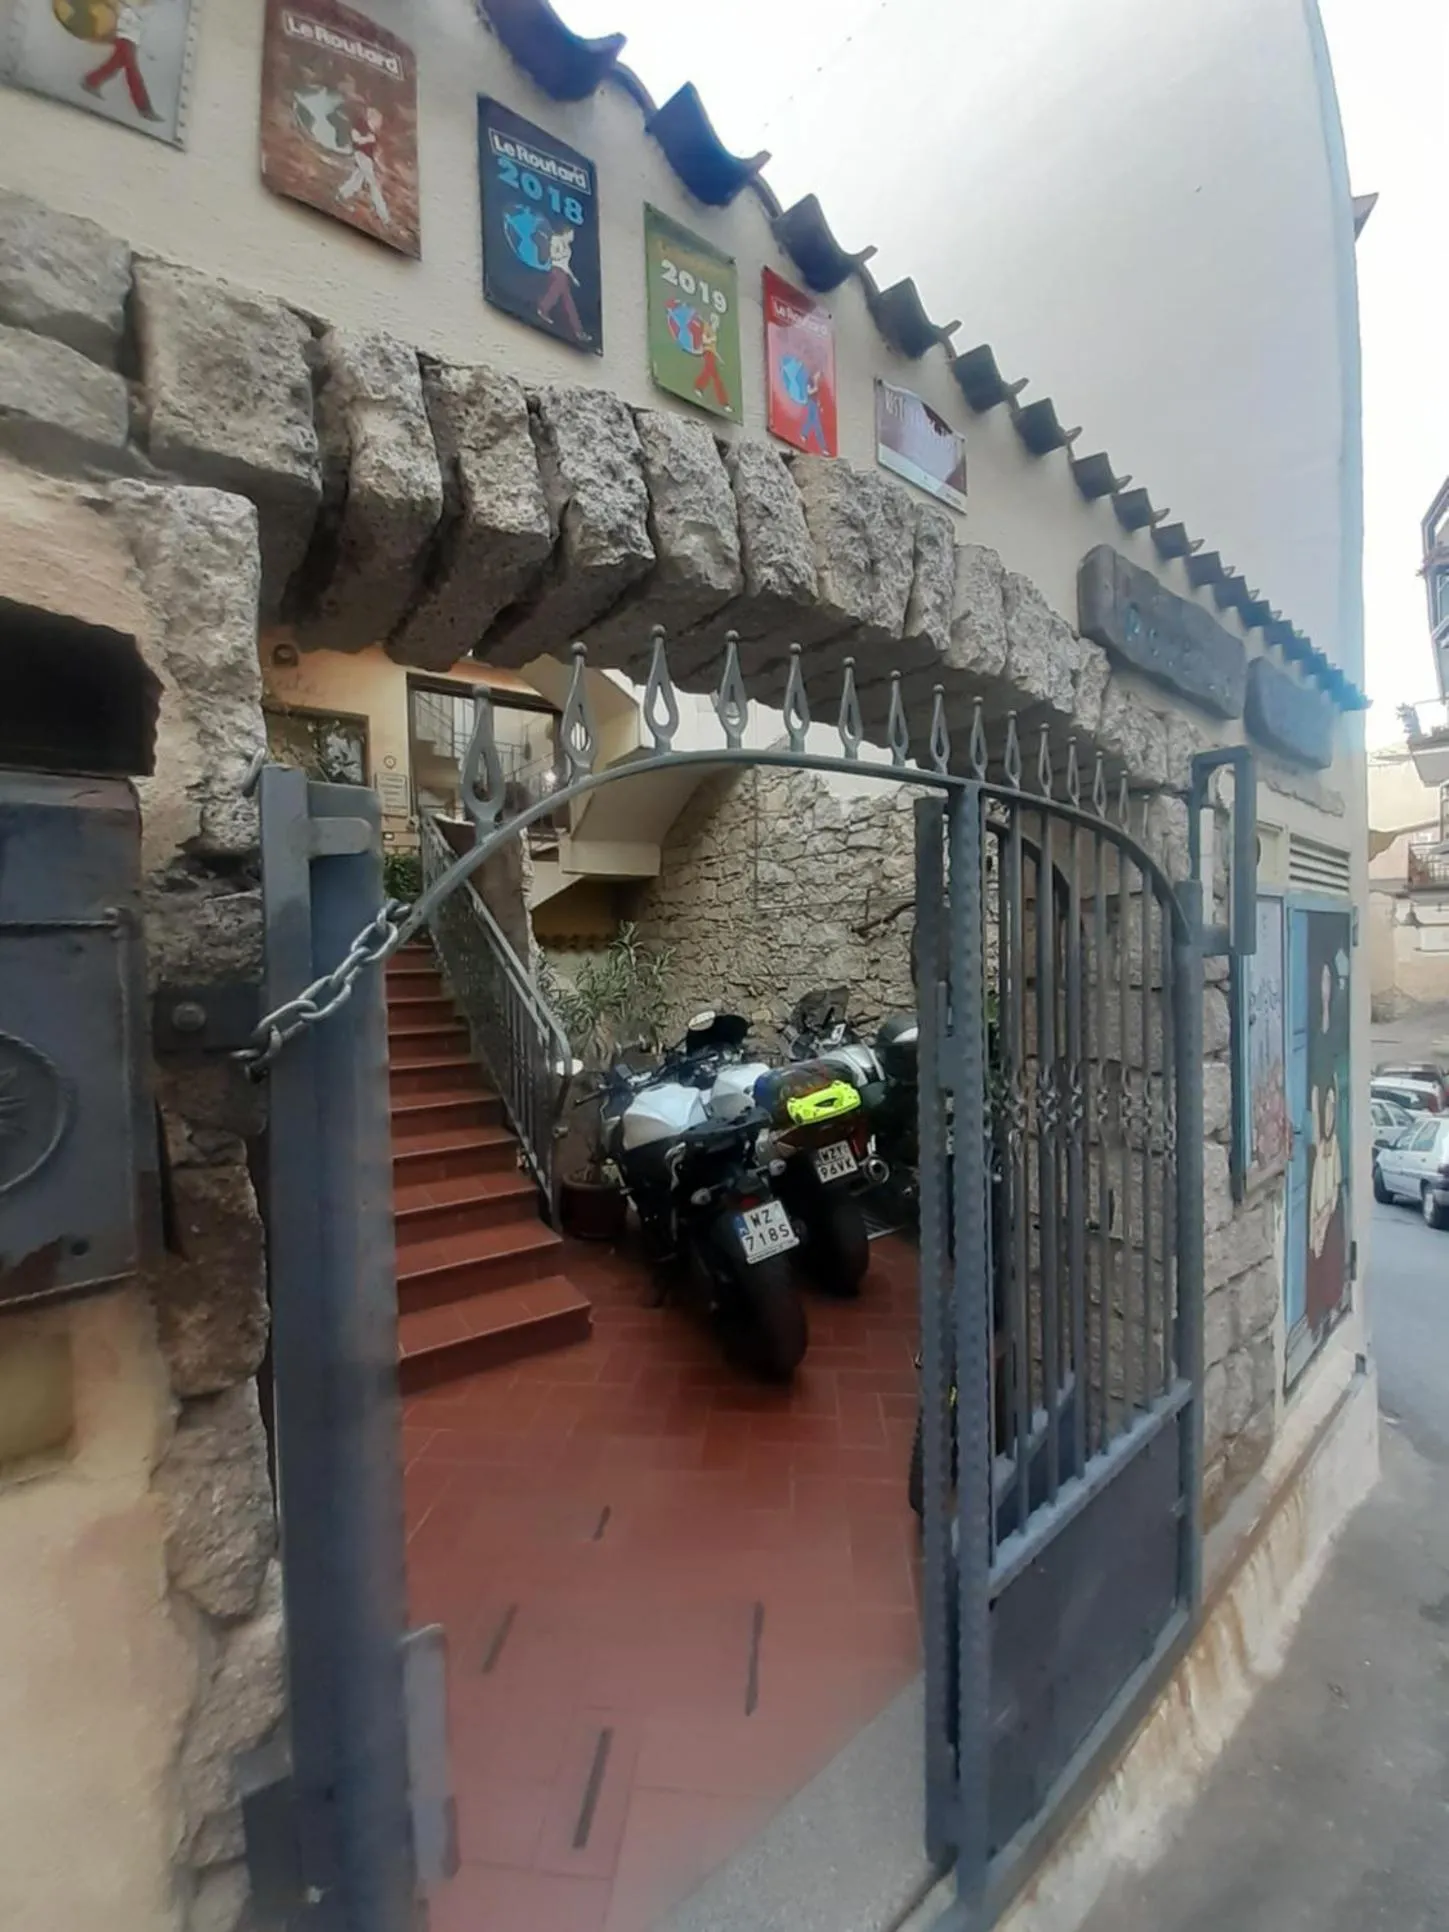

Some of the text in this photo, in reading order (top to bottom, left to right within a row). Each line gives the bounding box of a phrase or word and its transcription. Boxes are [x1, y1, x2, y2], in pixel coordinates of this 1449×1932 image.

[287, 17, 399, 74] Le Routard
[493, 134, 587, 189] Le Routard
[498, 155, 584, 225] 2018
[661, 259, 727, 313] 2019
[745, 1224, 789, 1251] 718S
[750, 1209, 773, 1228] WZ
